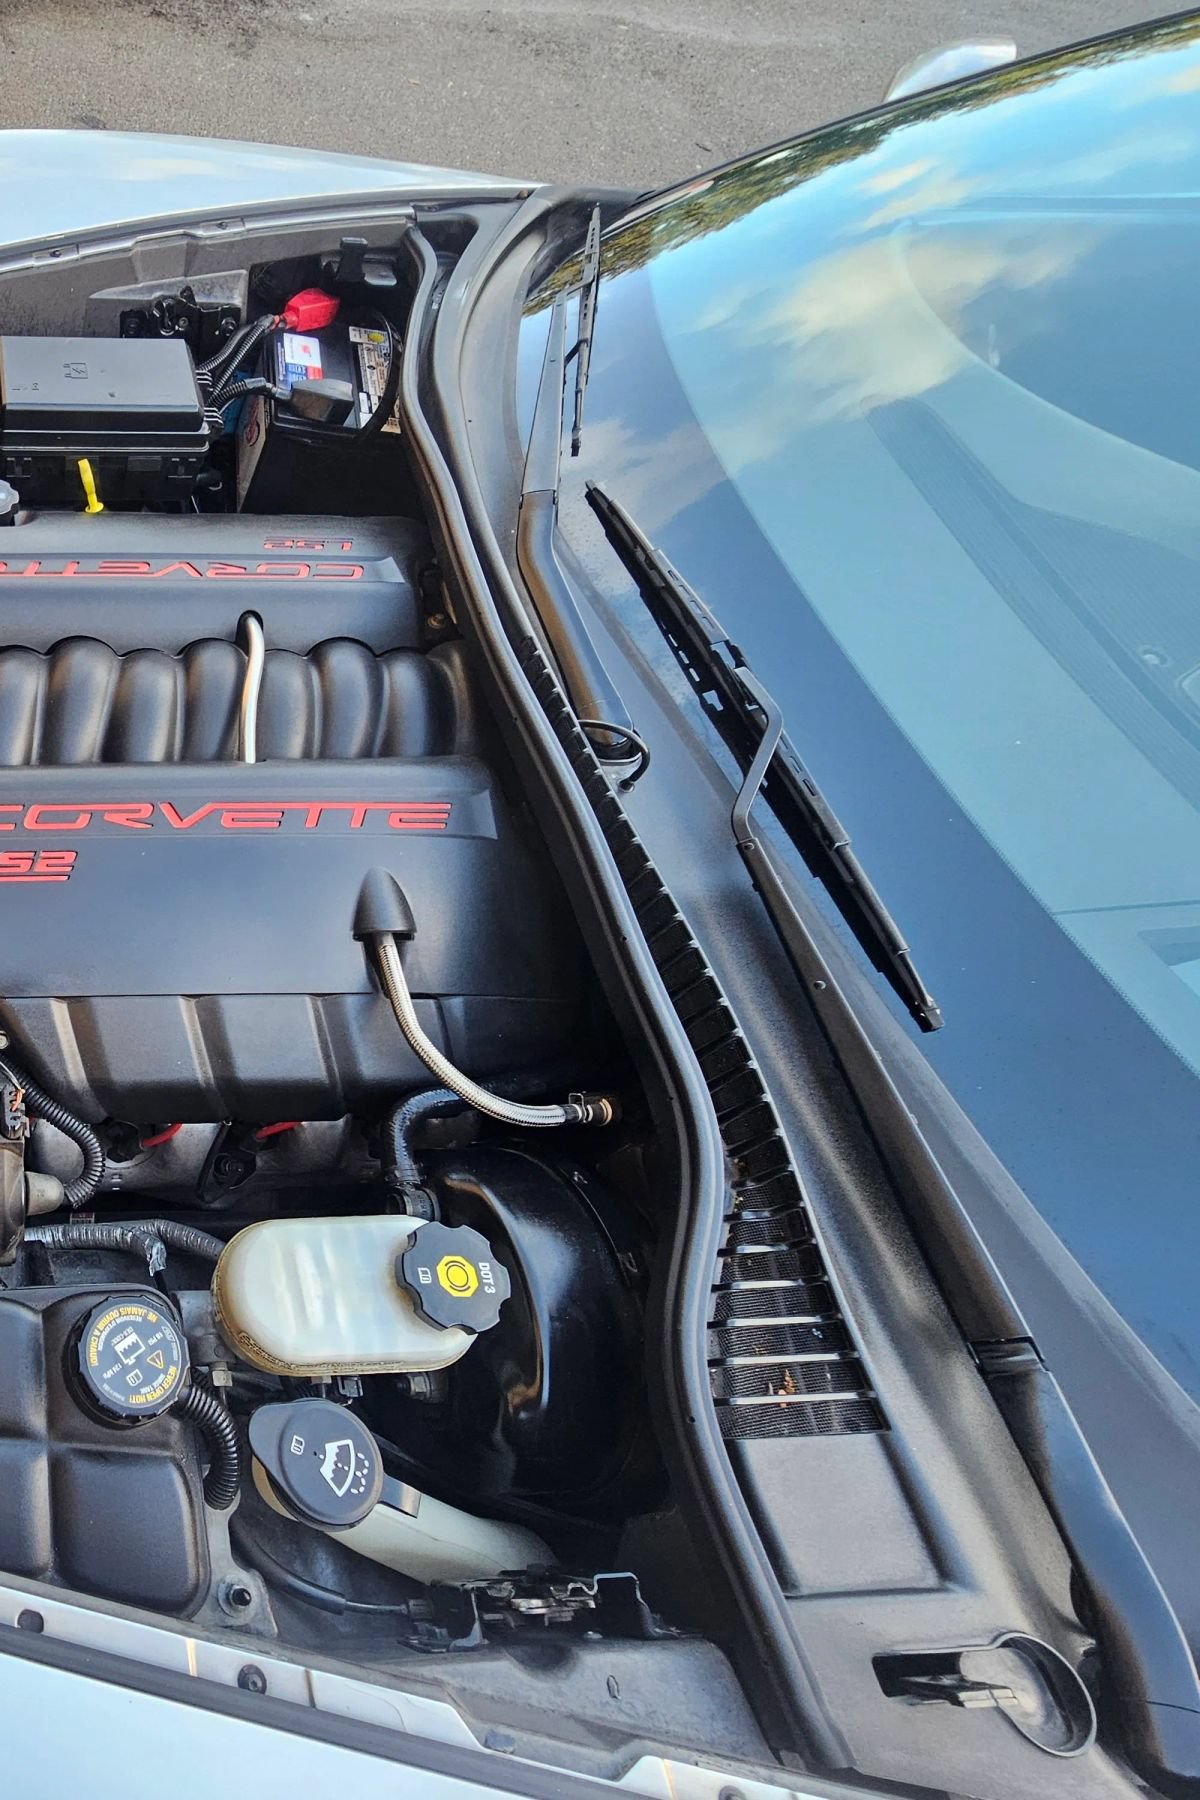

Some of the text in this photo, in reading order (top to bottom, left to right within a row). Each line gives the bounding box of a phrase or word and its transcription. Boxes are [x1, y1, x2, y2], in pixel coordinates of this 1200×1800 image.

[263, 538, 354, 551] LS2
[478, 1262, 496, 1294] DOT 3
[120, 1306, 146, 1317] JAMAIS
[146, 1312, 158, 1323] NE
[162, 1365, 177, 1390] NEVER
[146, 1385, 163, 1401] OPEN
